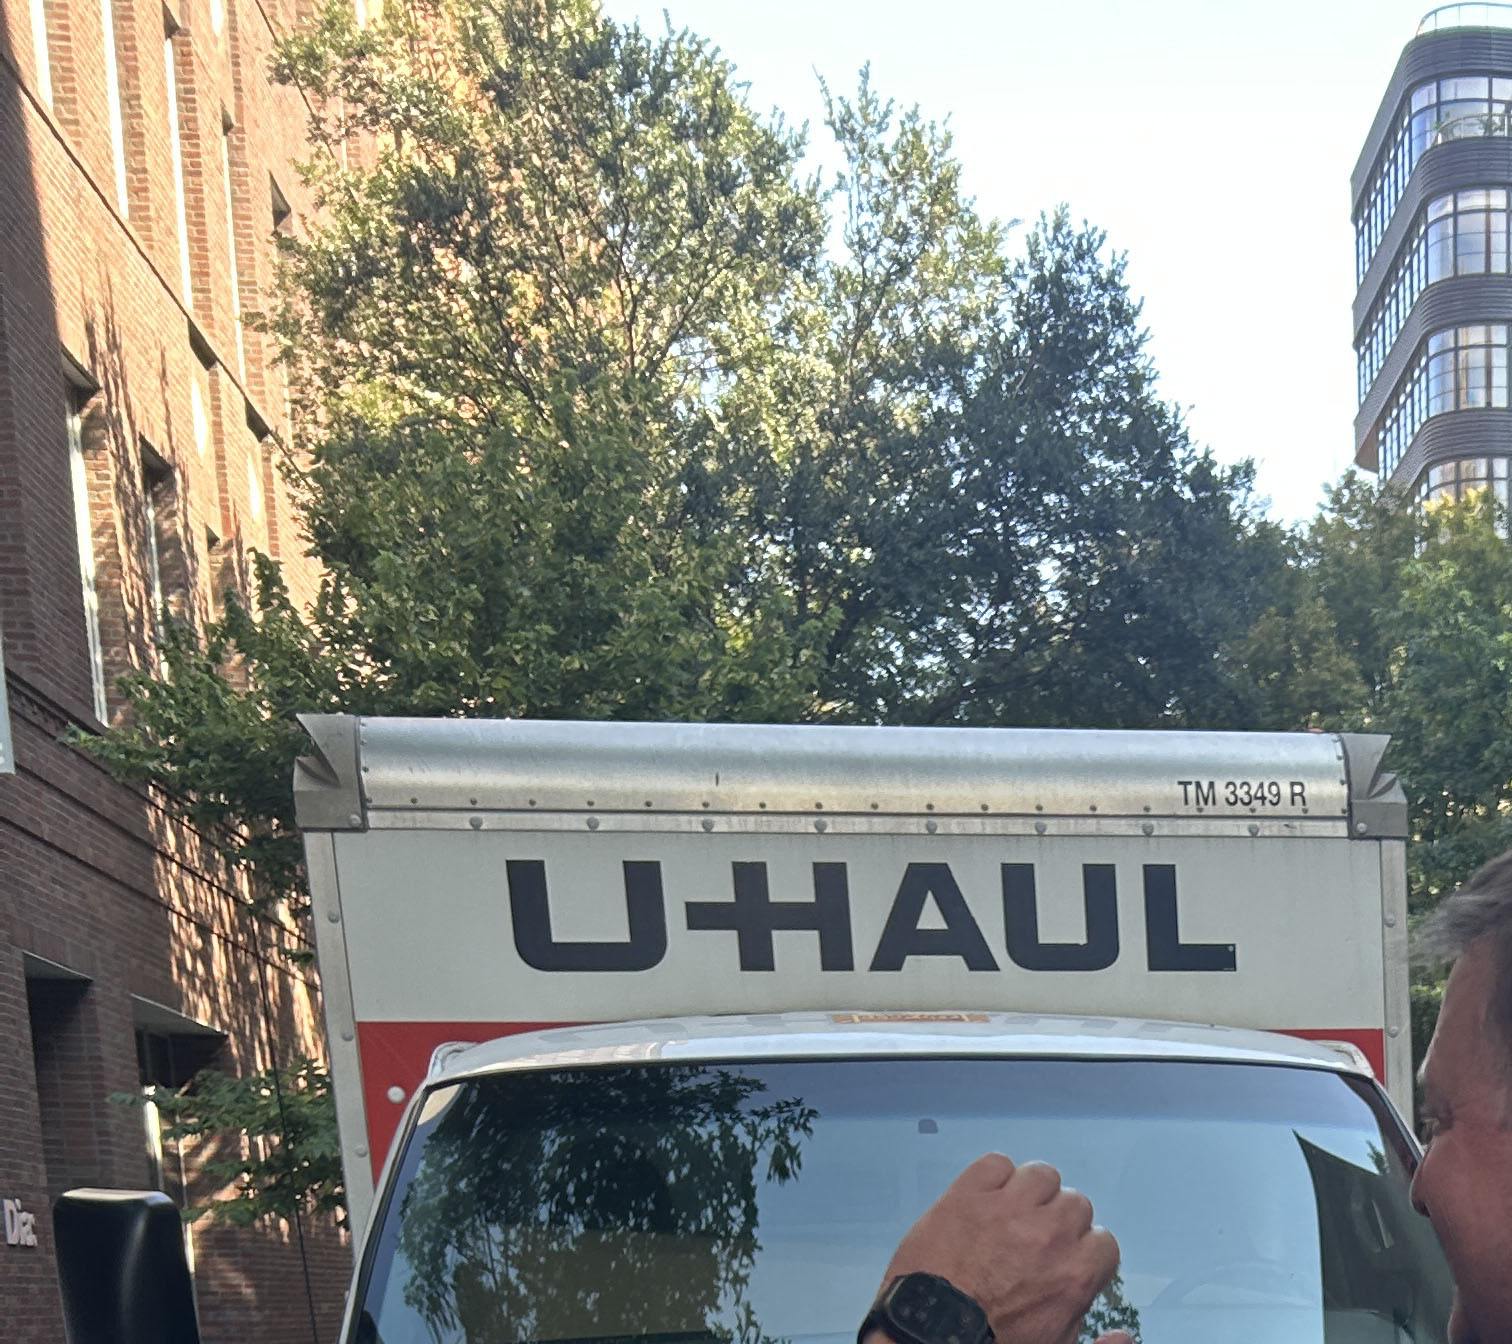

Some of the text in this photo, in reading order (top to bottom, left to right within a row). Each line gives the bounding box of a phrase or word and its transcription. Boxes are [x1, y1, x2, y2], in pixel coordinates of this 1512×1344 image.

[1177, 780, 1307, 807] TM 3349 R
[505, 859, 1237, 973] U-HAUL
